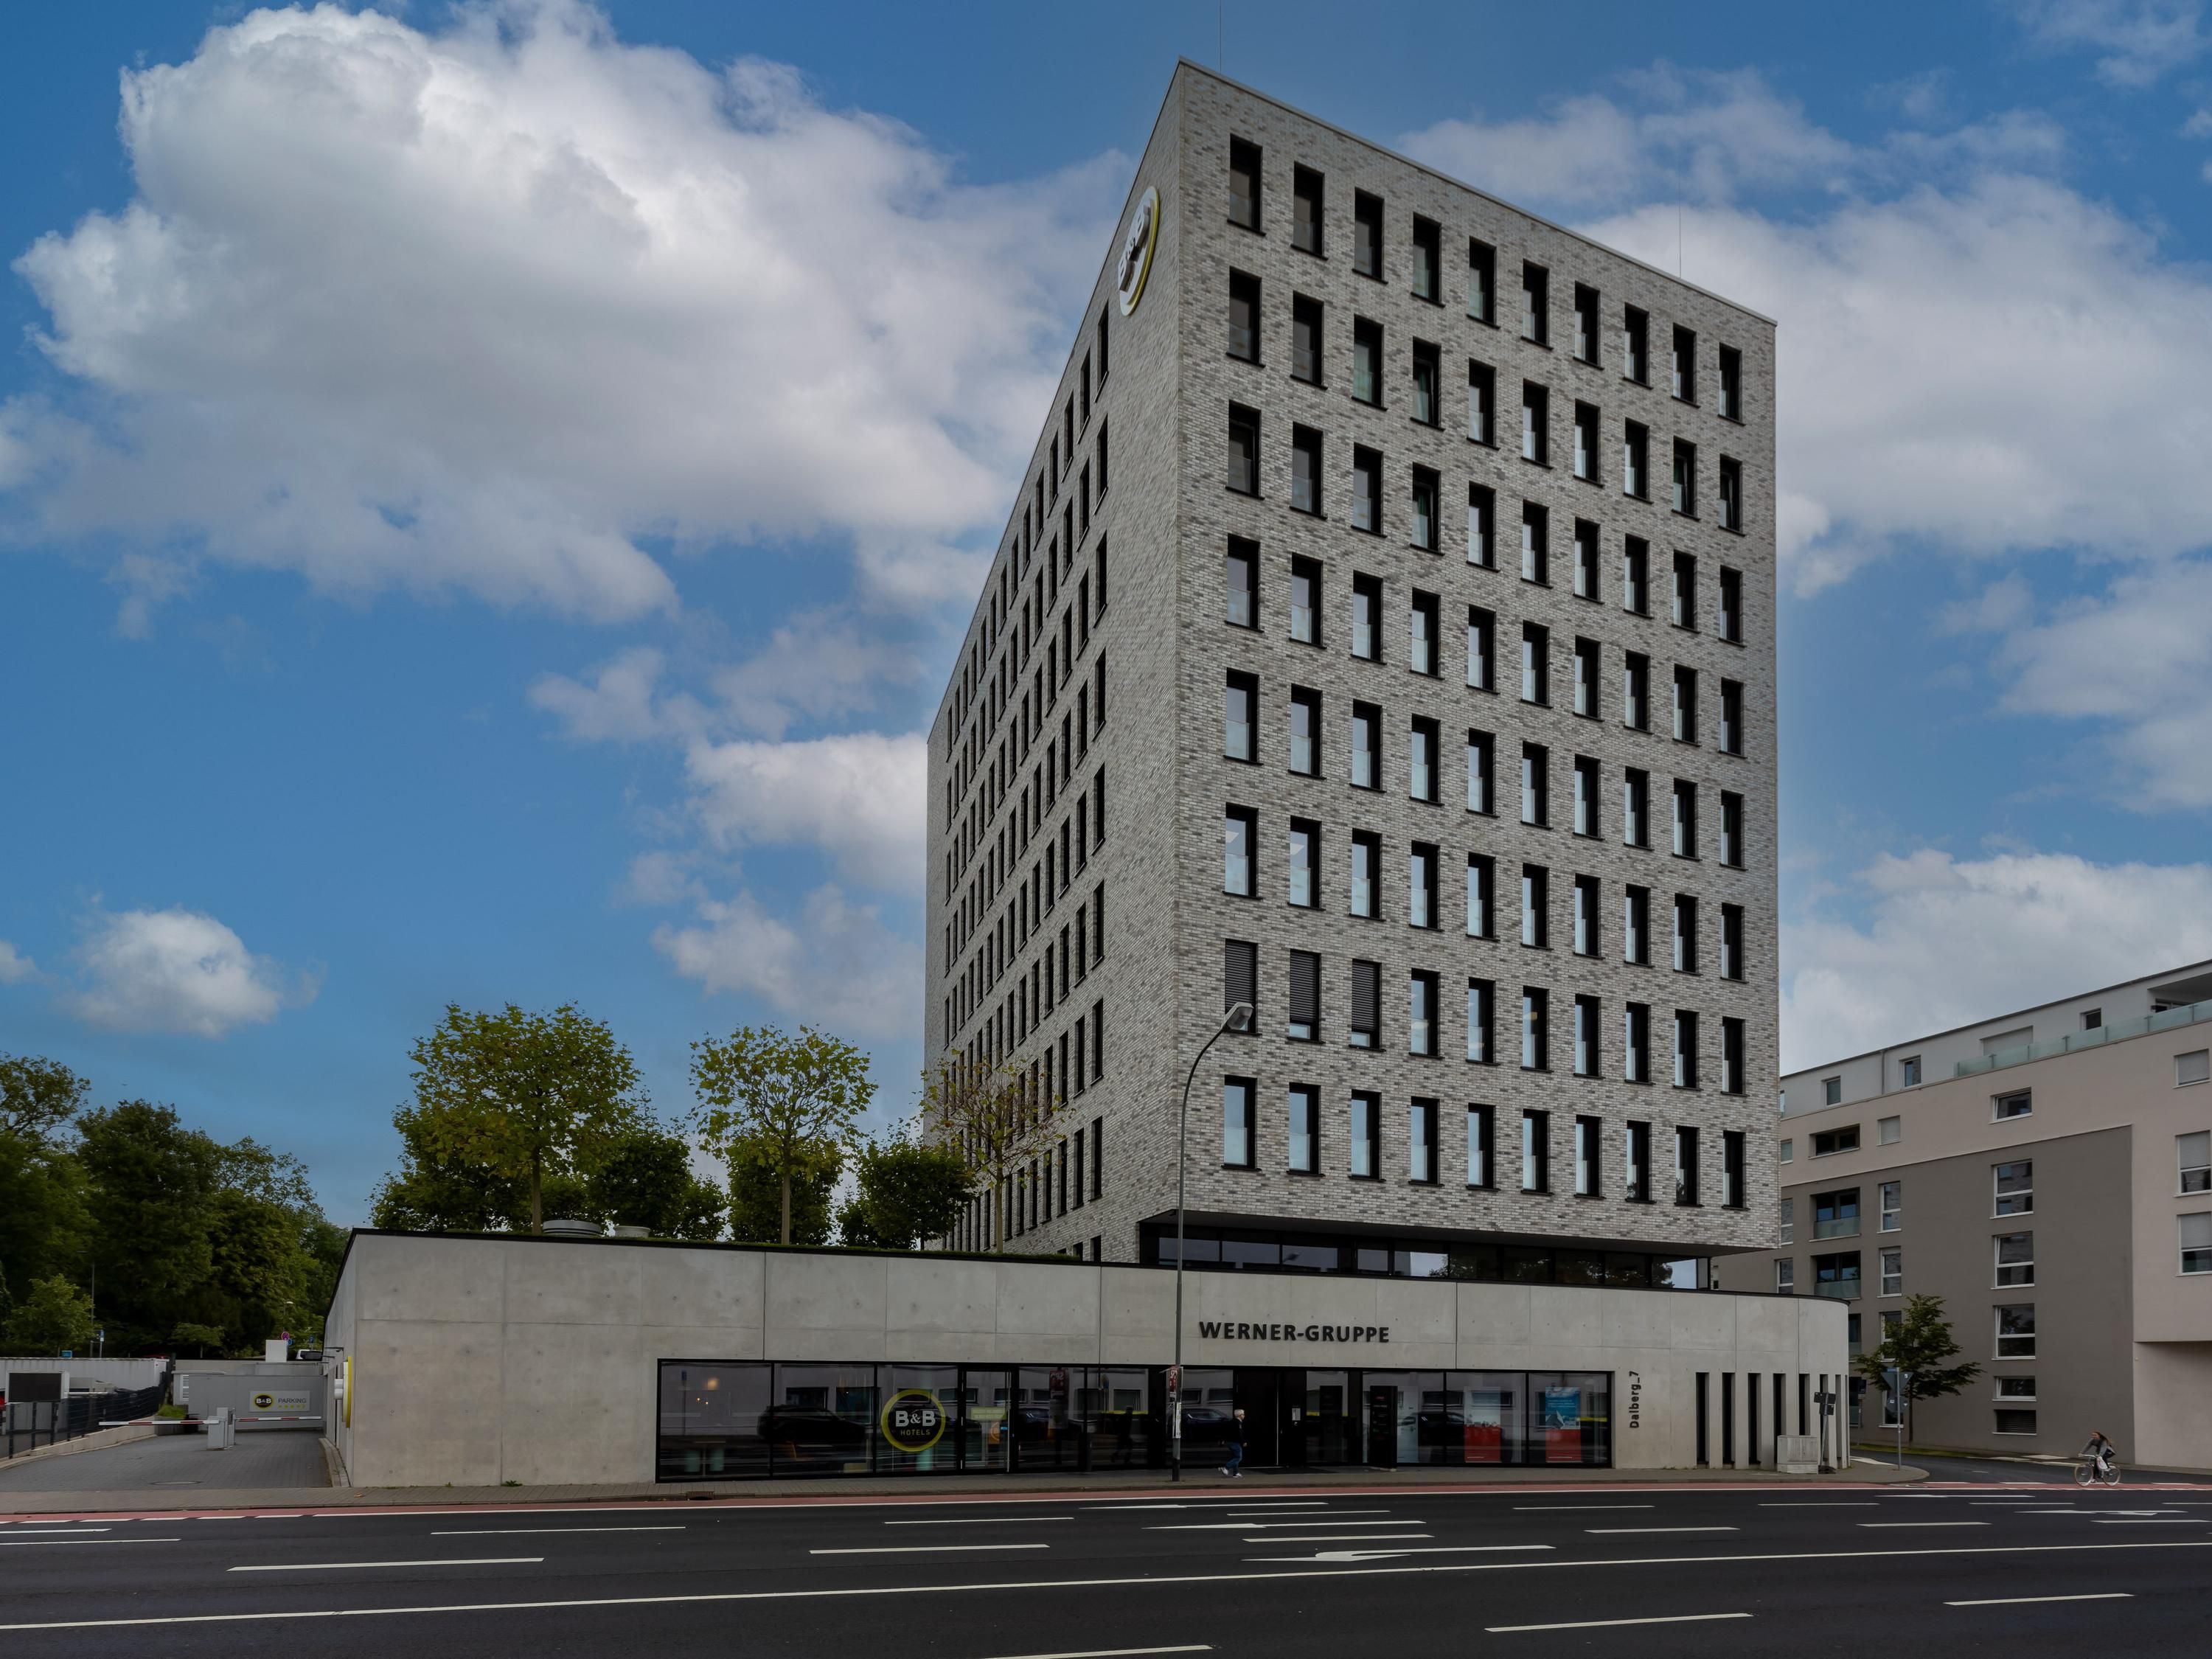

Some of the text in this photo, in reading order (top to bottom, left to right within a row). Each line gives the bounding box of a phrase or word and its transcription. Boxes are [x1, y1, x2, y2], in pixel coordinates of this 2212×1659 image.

[1198, 1321, 1390, 1343] WERNER-GRUPPE
[1628, 1371, 1641, 1428] Dalberg_7
[895, 1410, 936, 1427] B&B
